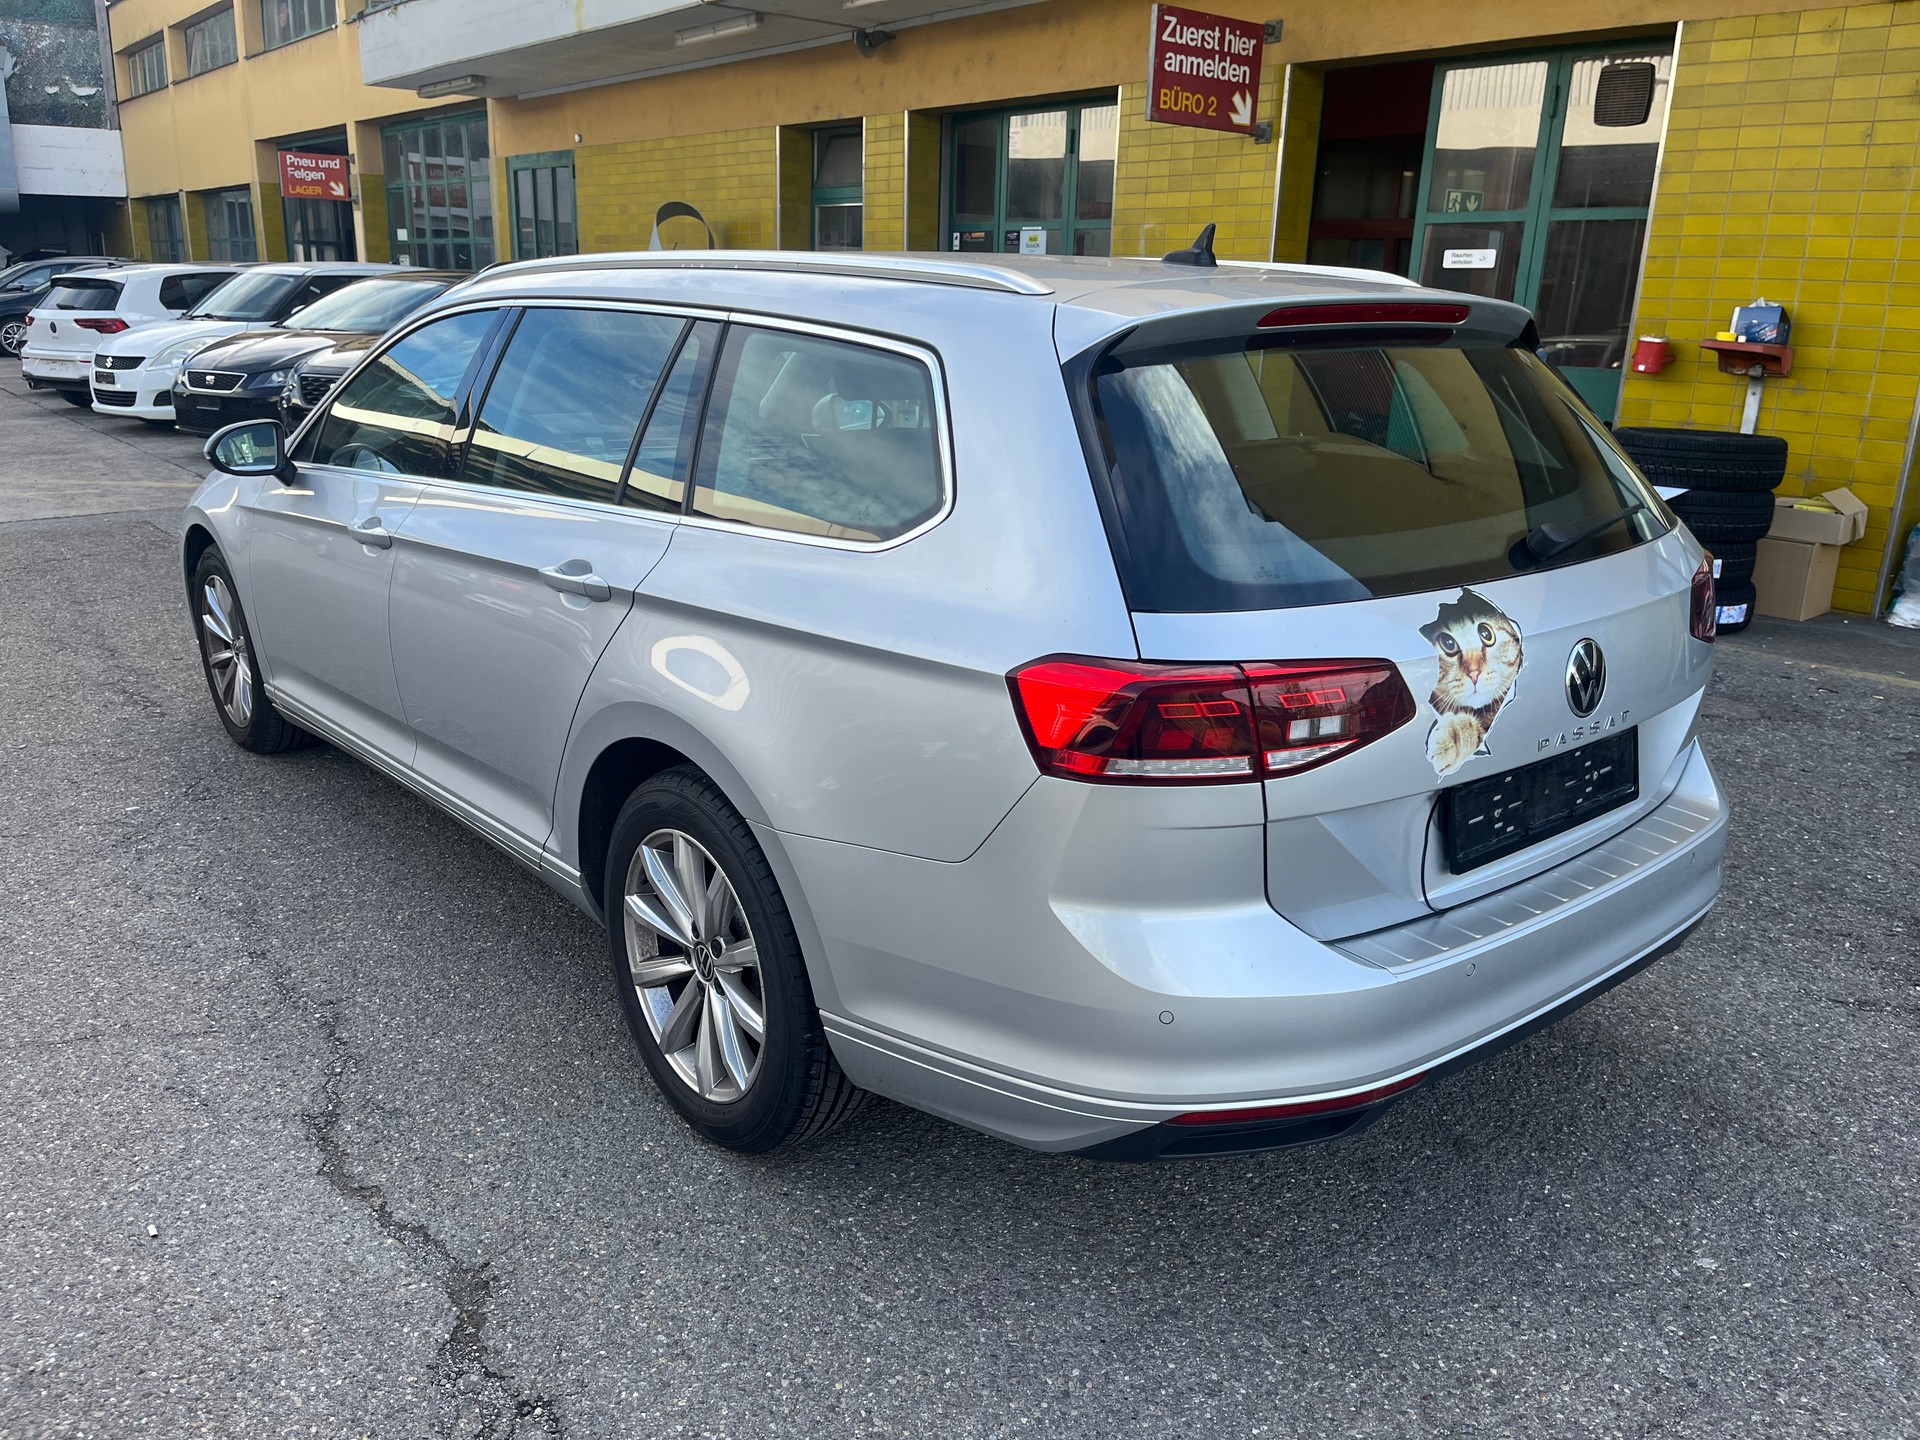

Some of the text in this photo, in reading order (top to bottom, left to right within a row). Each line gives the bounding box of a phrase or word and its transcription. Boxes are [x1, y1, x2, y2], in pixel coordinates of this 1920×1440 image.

[1162, 15, 1257, 57] Zuerst hier
[1164, 52, 1251, 85] anmelden
[1160, 86, 1218, 117] BÜRO 2
[286, 154, 340, 169] Pneu und
[287, 167, 326, 181] Felgen
[289, 184, 322, 195] LAGER
[1537, 710, 1630, 752] PASSAT
